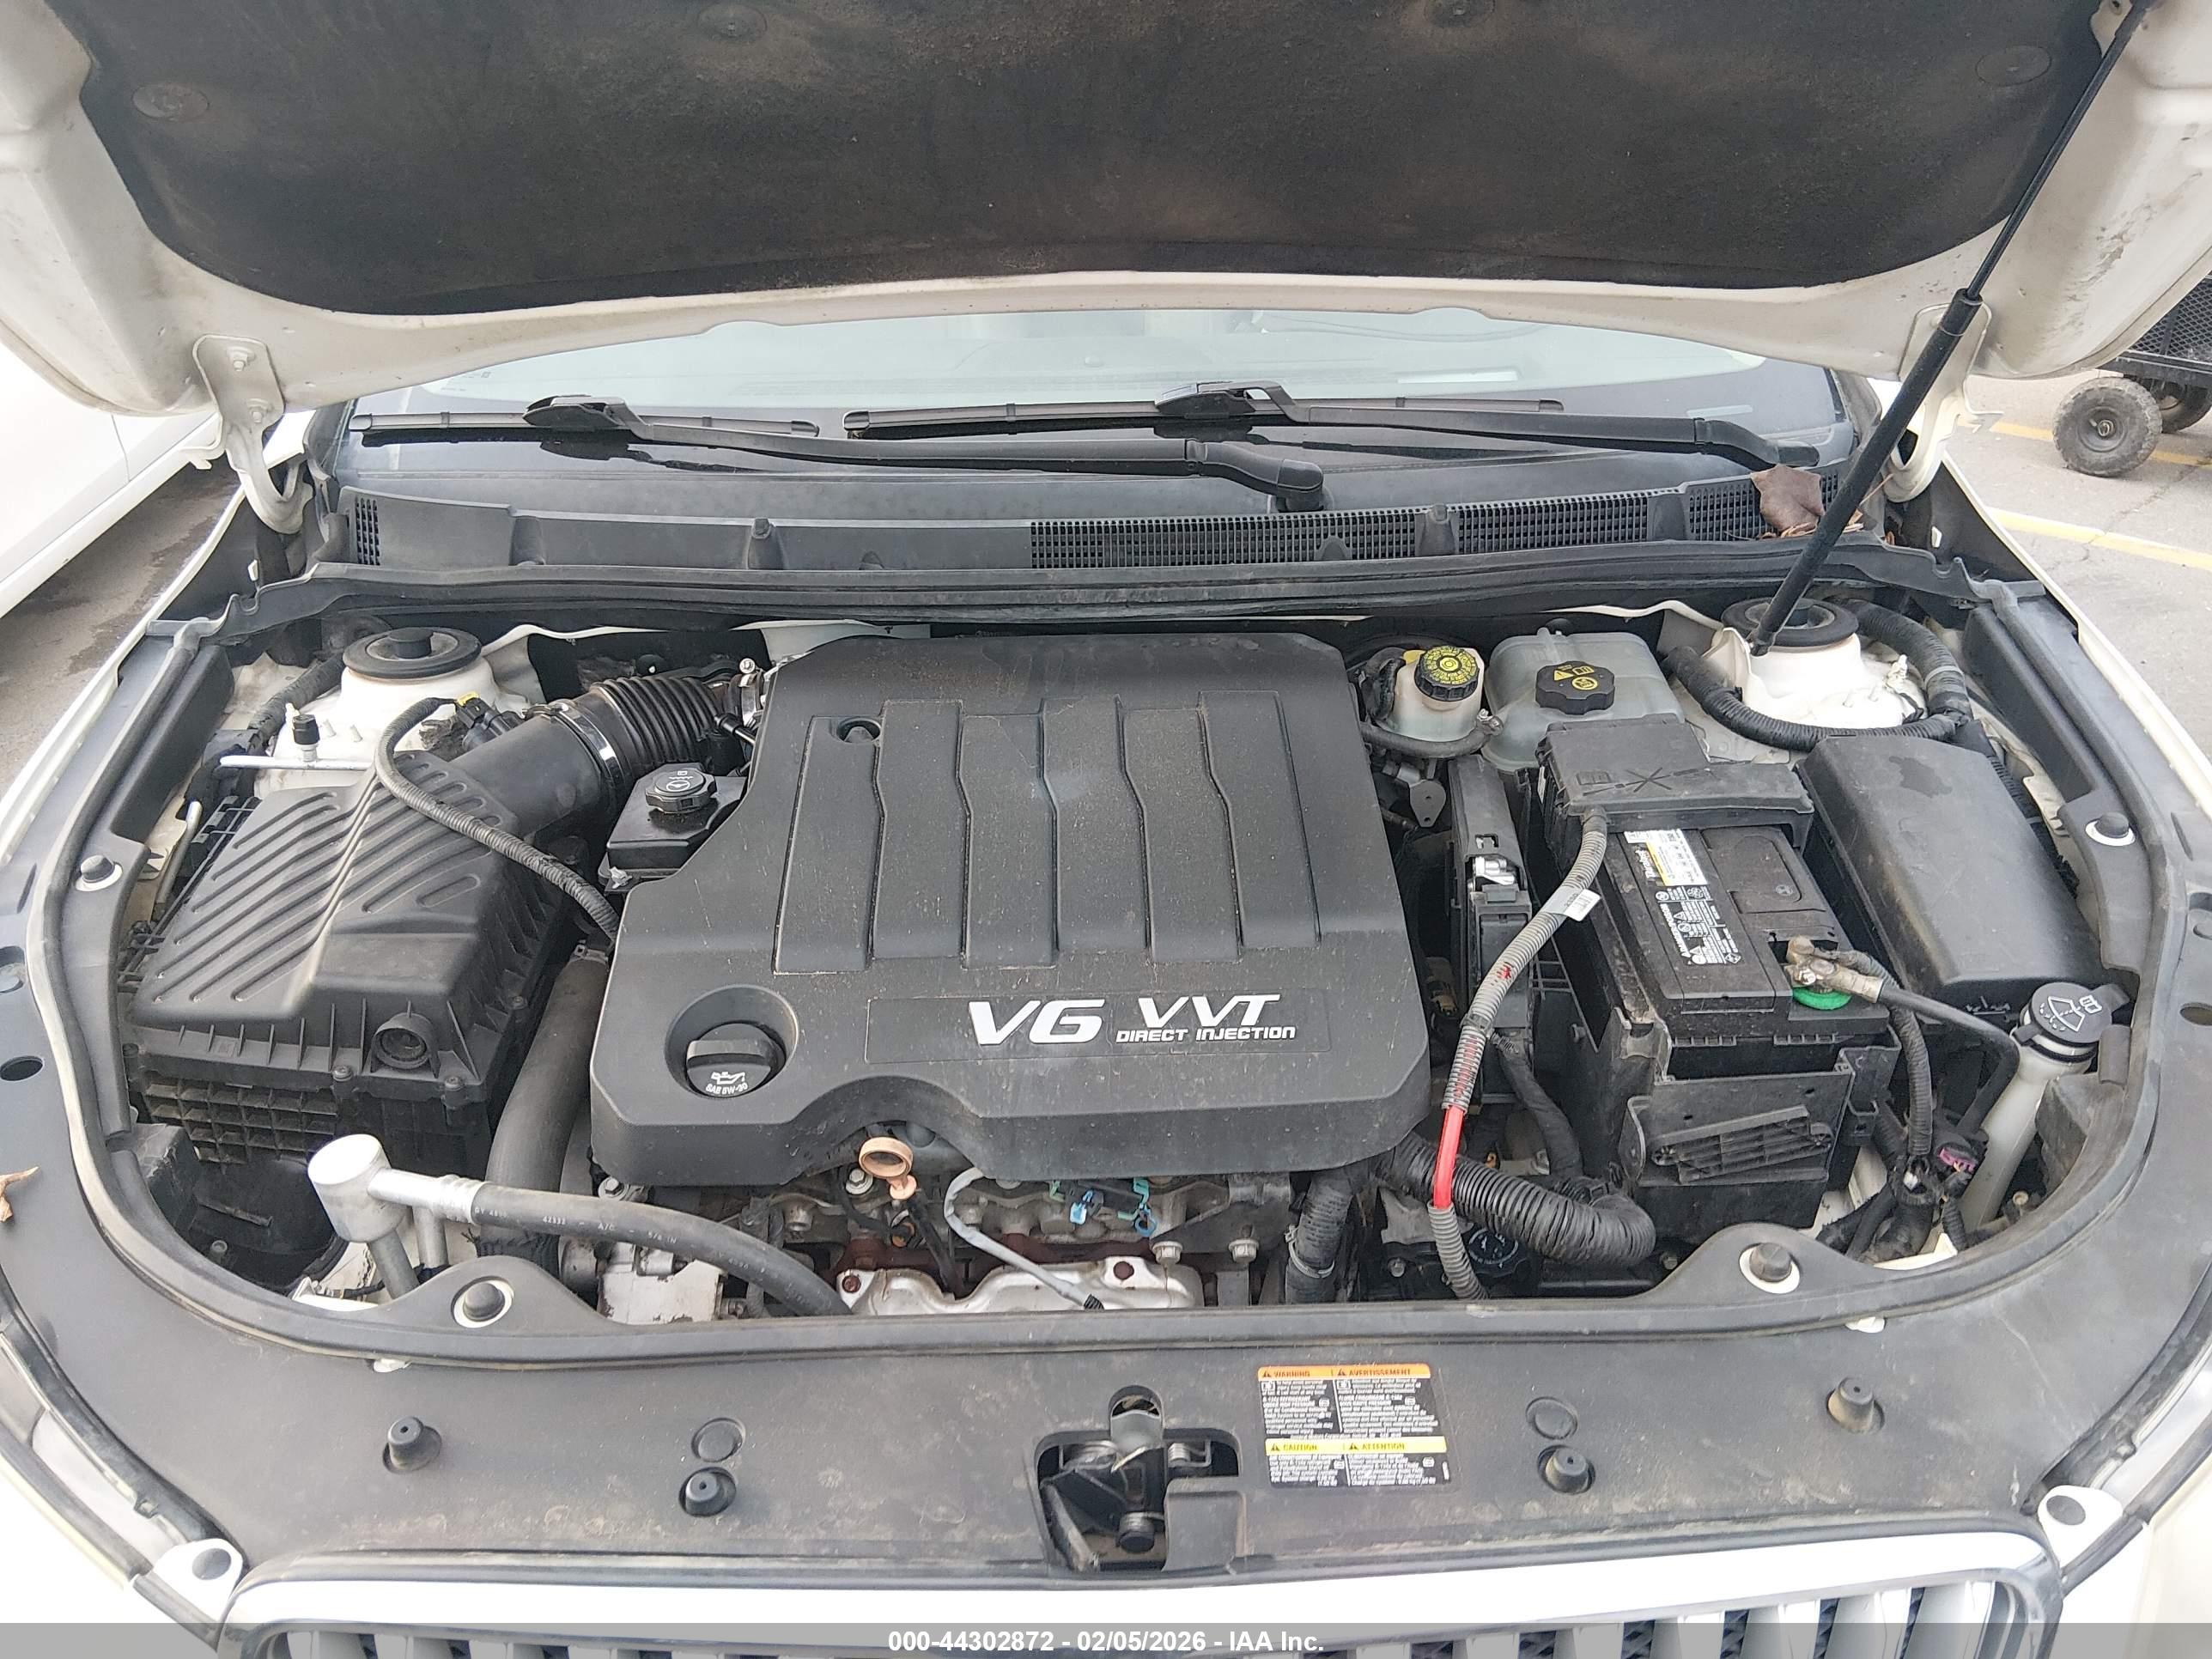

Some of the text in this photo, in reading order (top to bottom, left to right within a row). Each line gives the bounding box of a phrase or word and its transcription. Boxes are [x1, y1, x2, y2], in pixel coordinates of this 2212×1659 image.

[969, 994, 1281, 1046] V6 VVT
[1115, 1026, 1297, 1044] DIRECT INJECTION
[705, 1082, 748, 1095] SAE 5W-30
[1349, 1368, 1411, 1376] AVERTISSEMENT
[1362, 1442, 1406, 1451] ATTENTION
